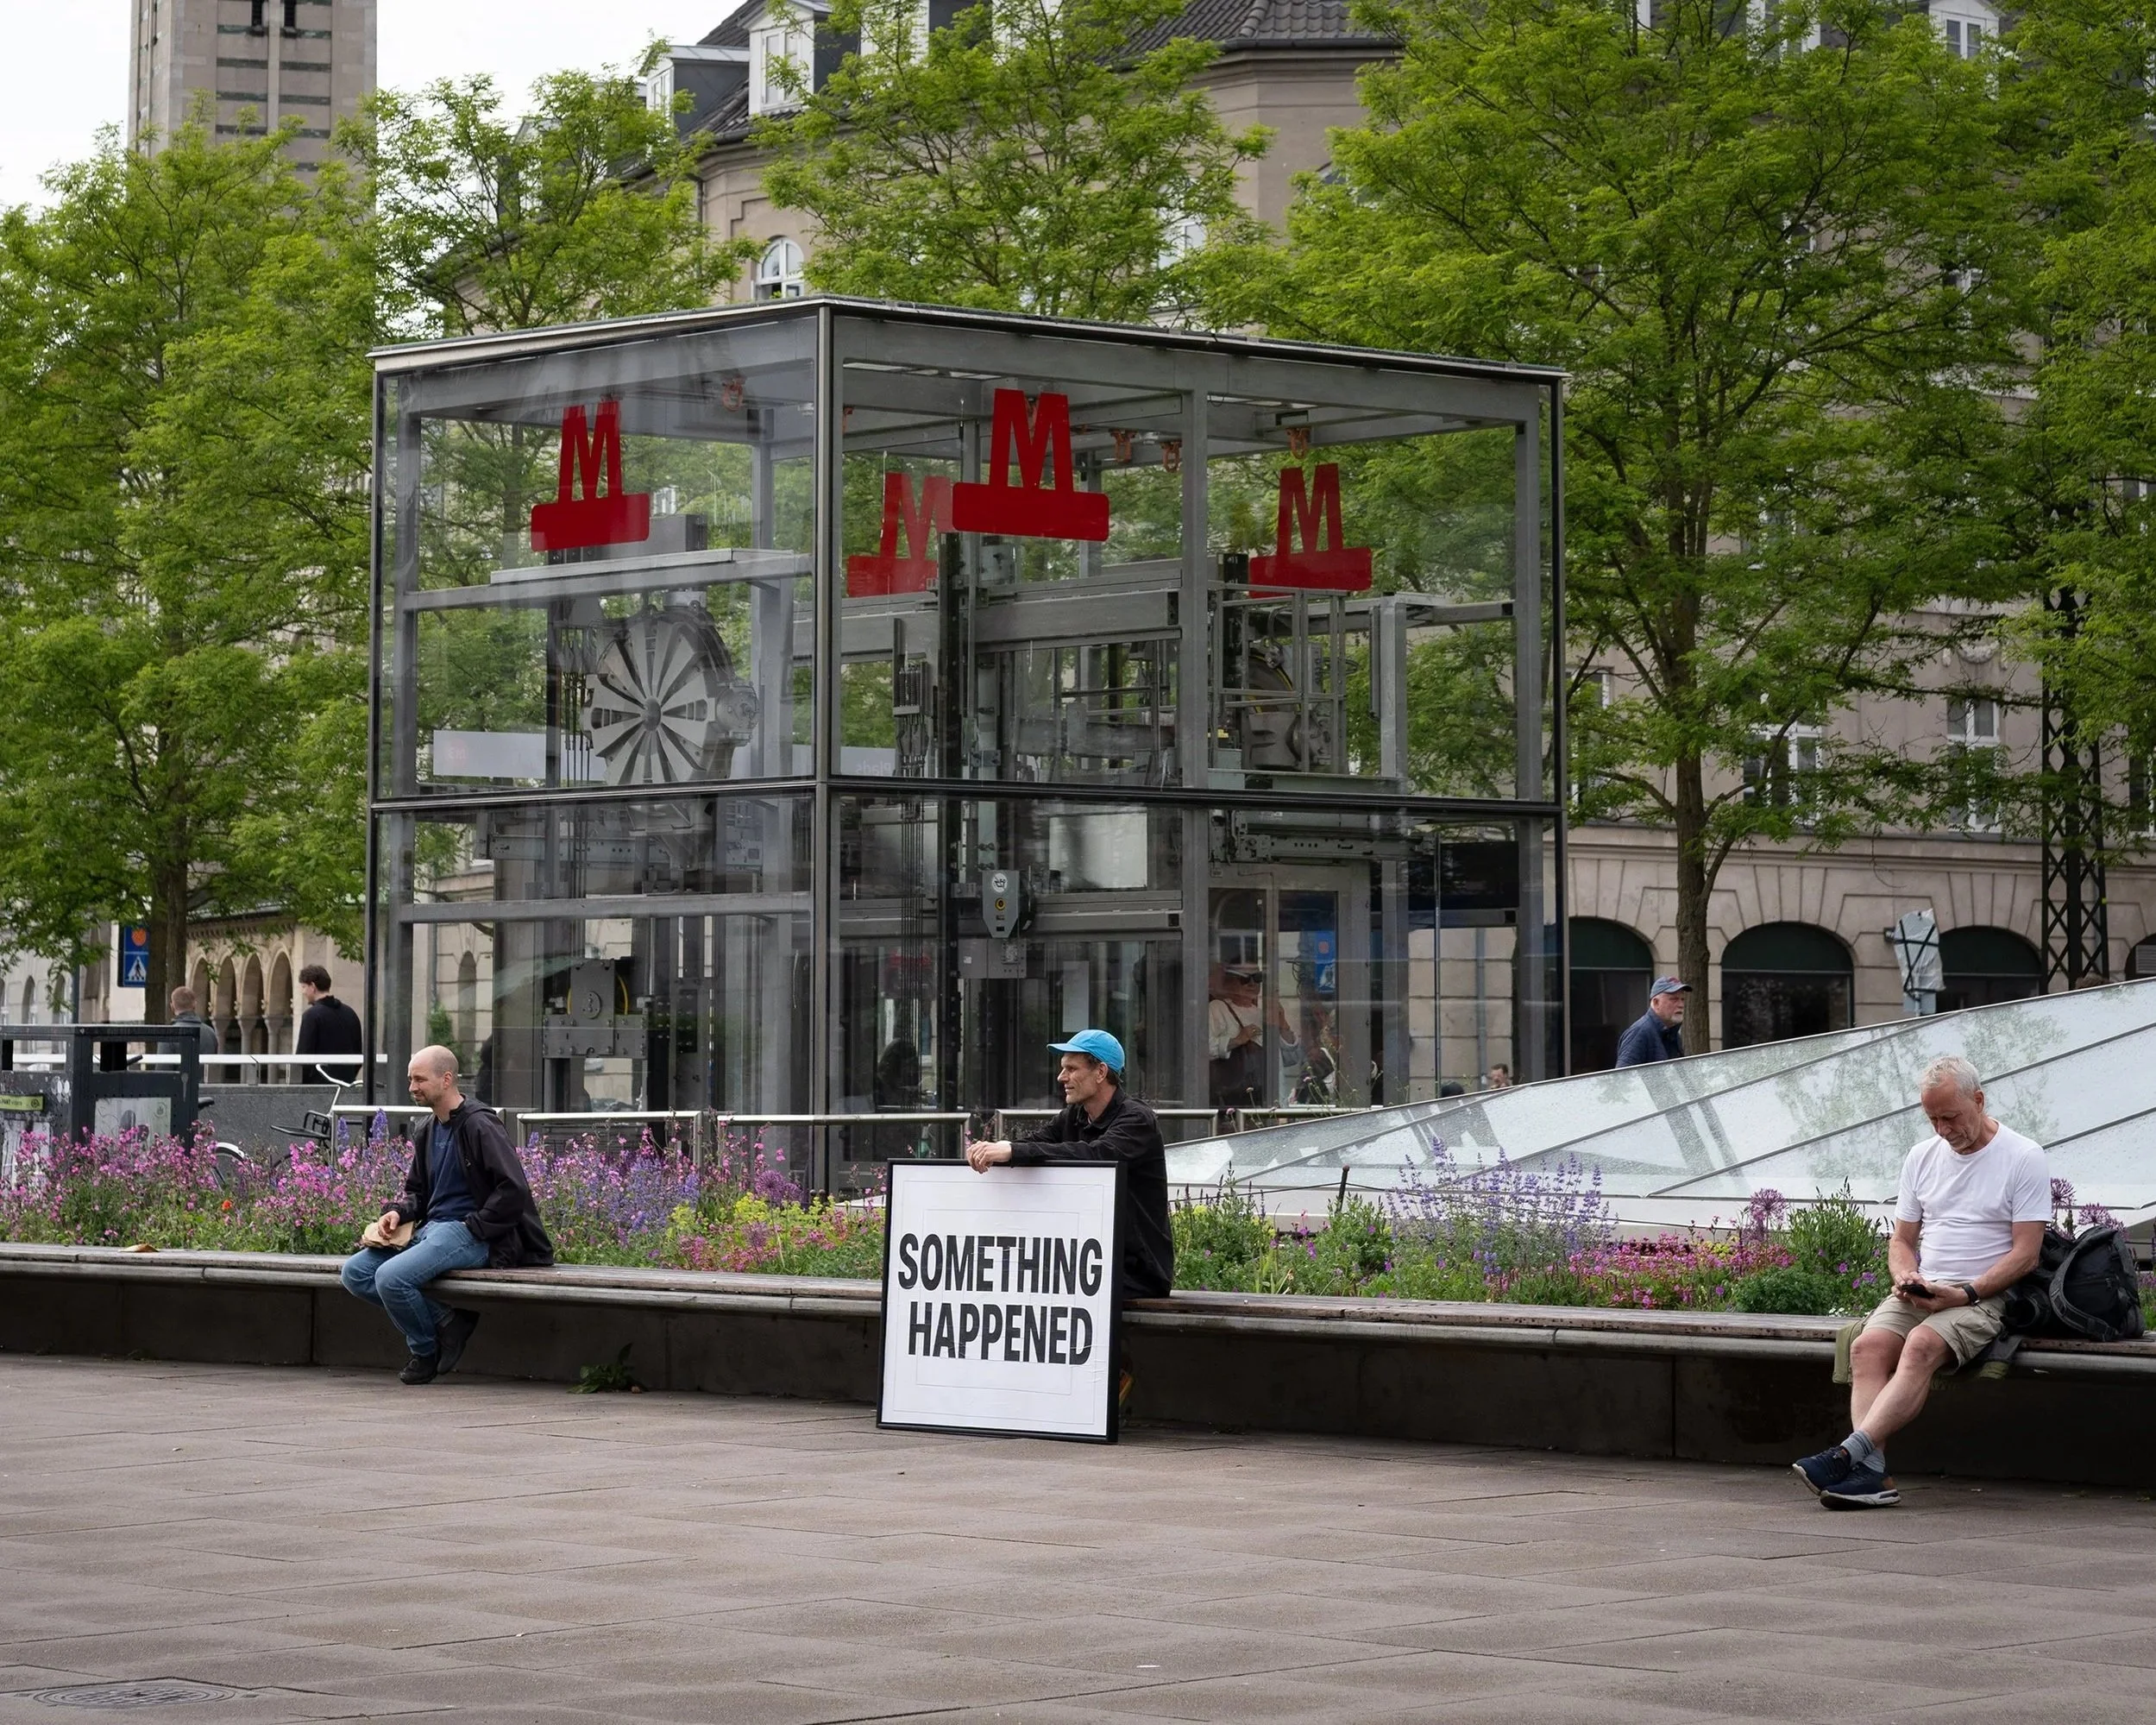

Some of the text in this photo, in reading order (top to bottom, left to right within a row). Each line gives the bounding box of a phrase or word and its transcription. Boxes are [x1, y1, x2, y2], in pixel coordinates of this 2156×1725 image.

[557, 400, 623, 504] M
[989, 388, 1074, 490] M
[879, 472, 953, 559] M
[1277, 463, 1343, 557] M
[898, 1232, 1103, 1297] SOMETHING
[908, 1301, 1093, 1365] HAPPENED
